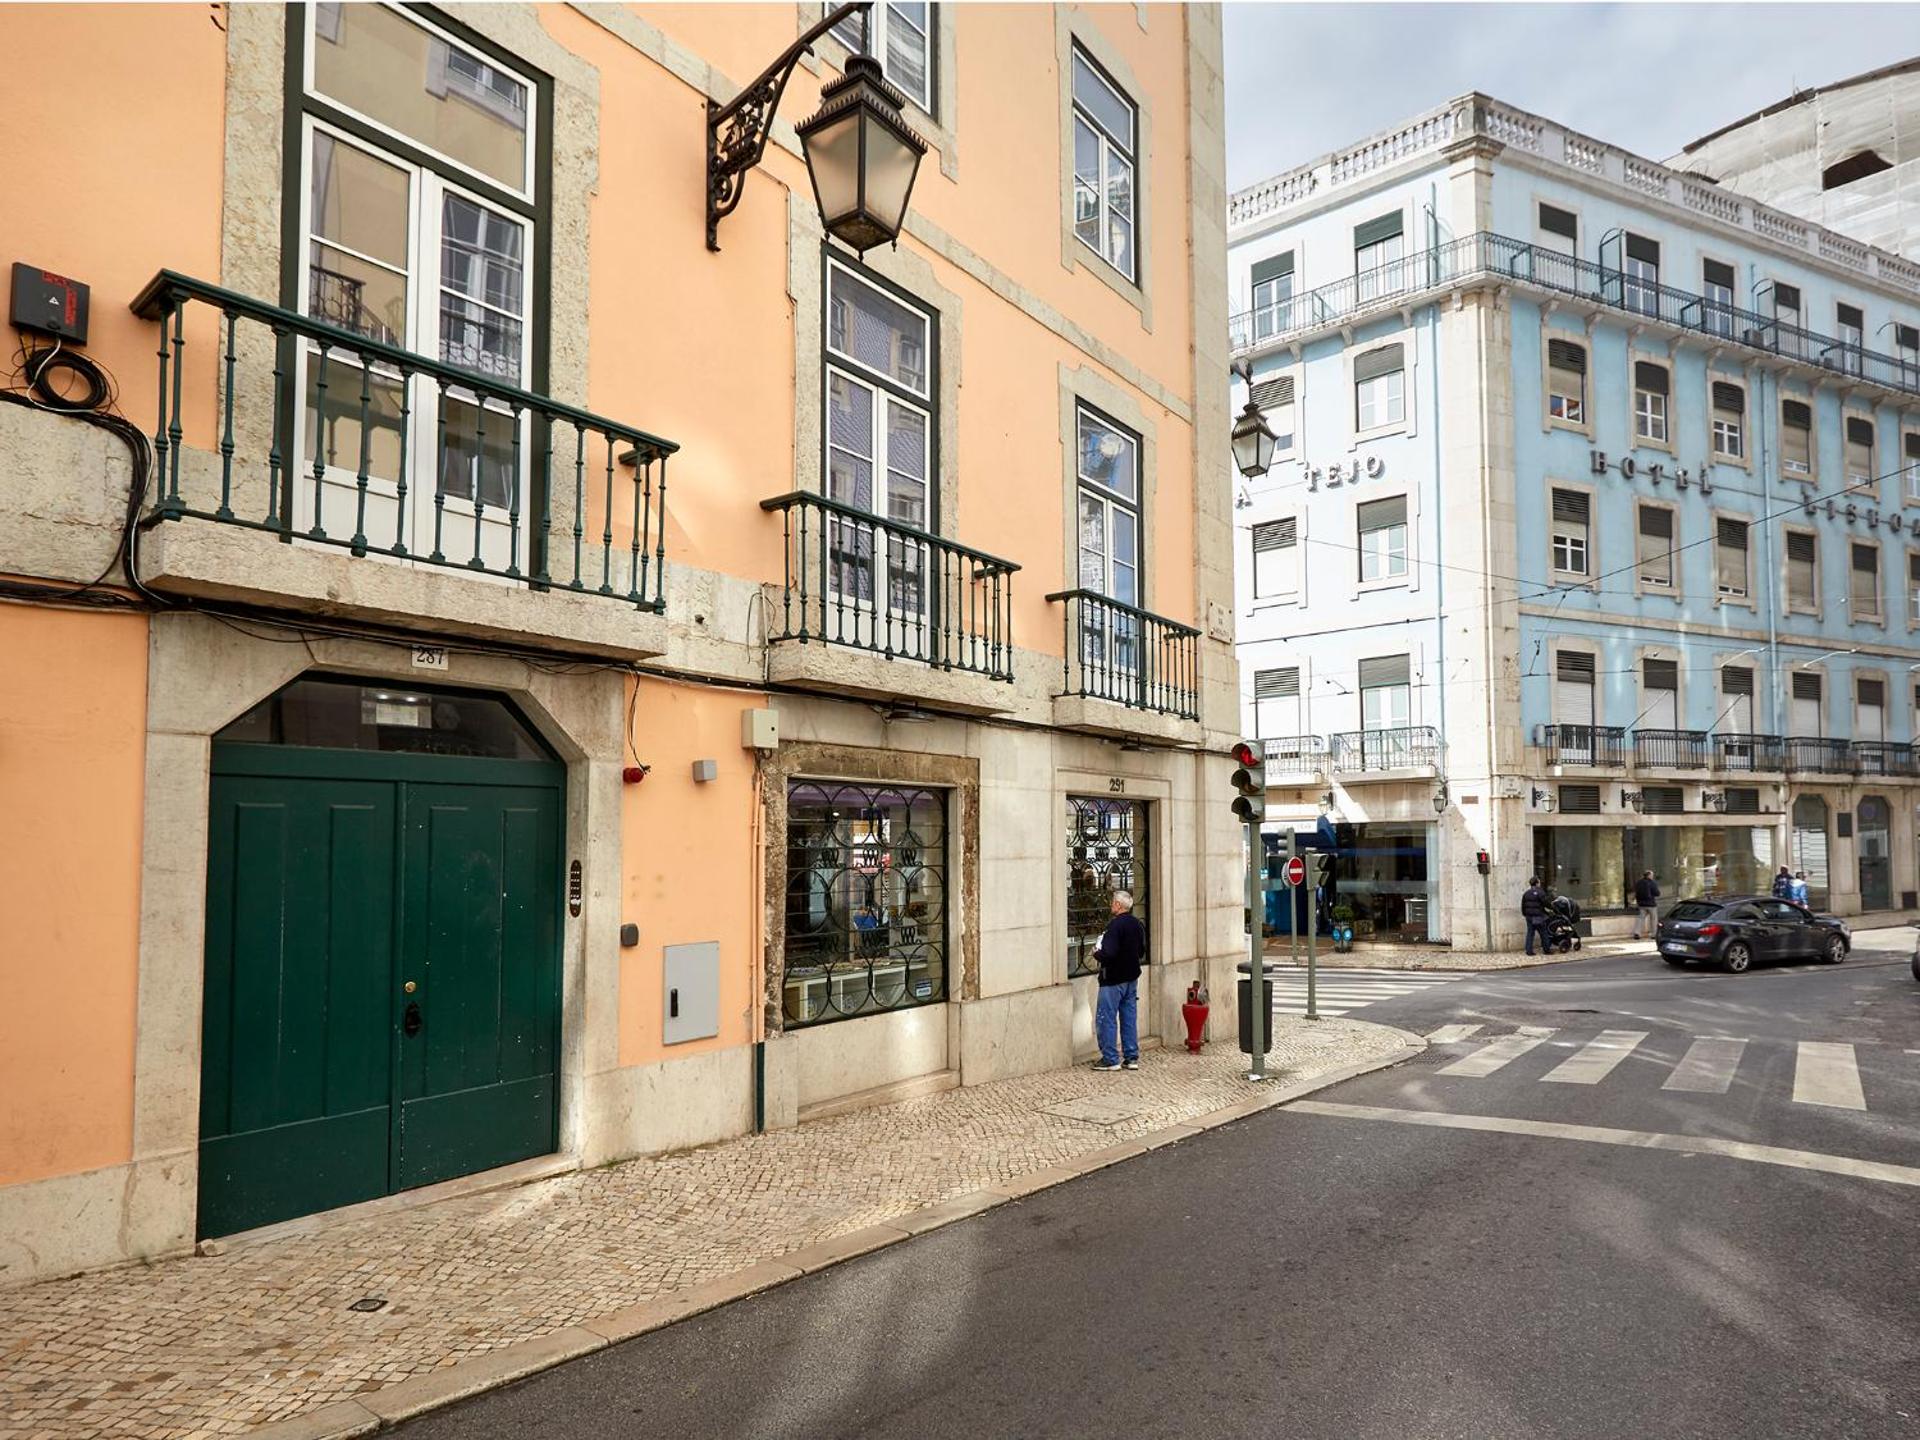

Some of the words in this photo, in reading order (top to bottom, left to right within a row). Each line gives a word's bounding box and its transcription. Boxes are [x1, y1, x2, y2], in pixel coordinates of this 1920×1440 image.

[1303, 455, 1386, 493] TEJO
[1590, 450, 1713, 494] HOTEL
[416, 646, 445, 665] 287
[1109, 777, 1125, 793] 291
